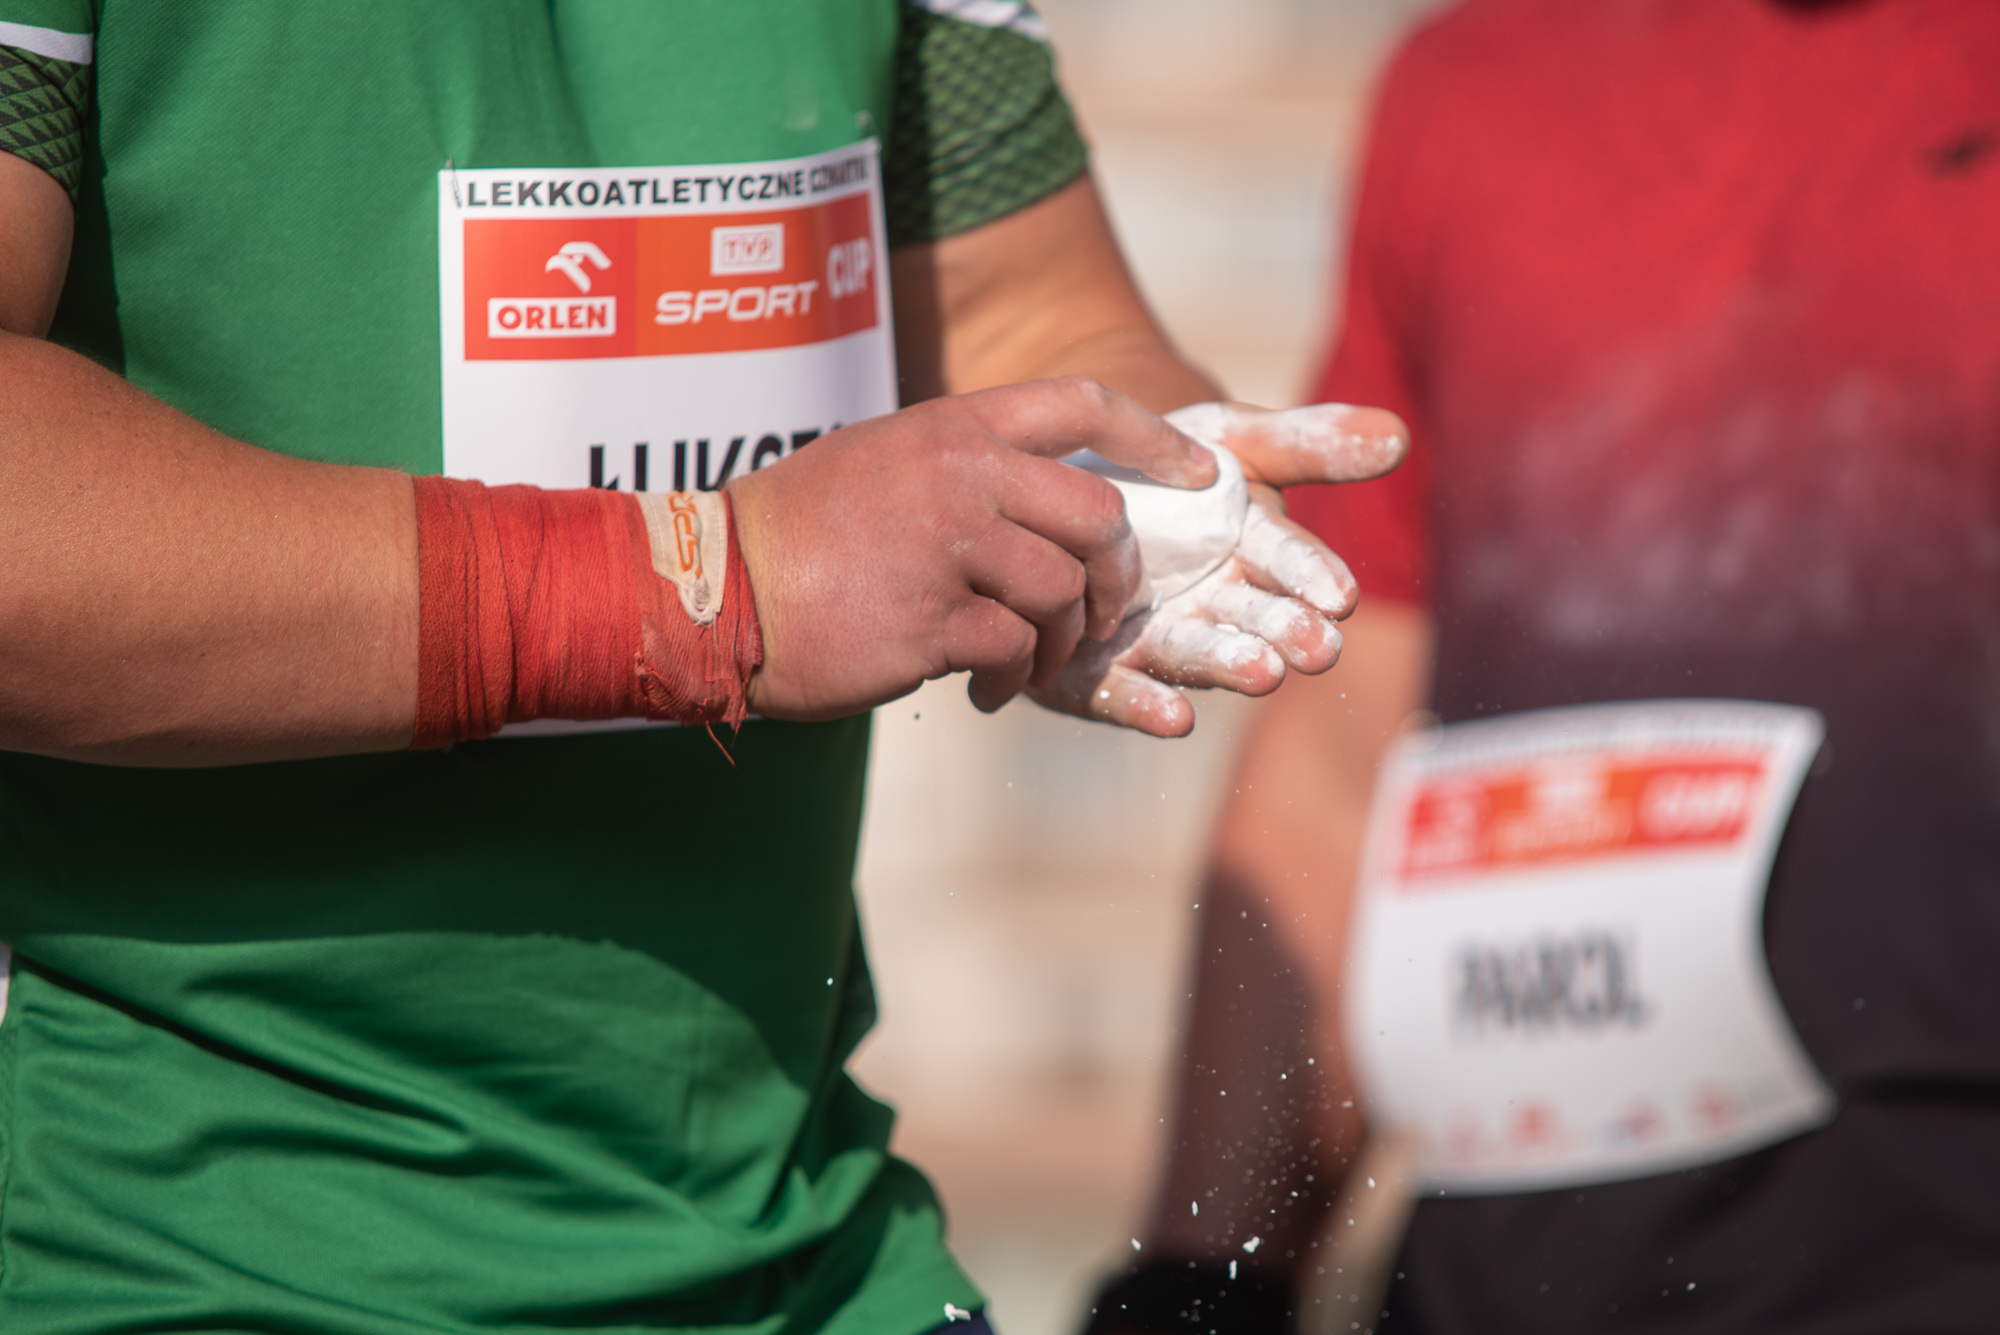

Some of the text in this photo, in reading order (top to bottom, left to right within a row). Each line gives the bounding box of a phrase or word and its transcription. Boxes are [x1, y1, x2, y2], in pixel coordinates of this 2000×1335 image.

[467, 169, 805, 207] LEKKOATLETYCZNE
[724, 237, 772, 263] TVP
[827, 236, 869, 300] CUP
[498, 303, 606, 330] ORLEN
[654, 280, 818, 325] SPORT
